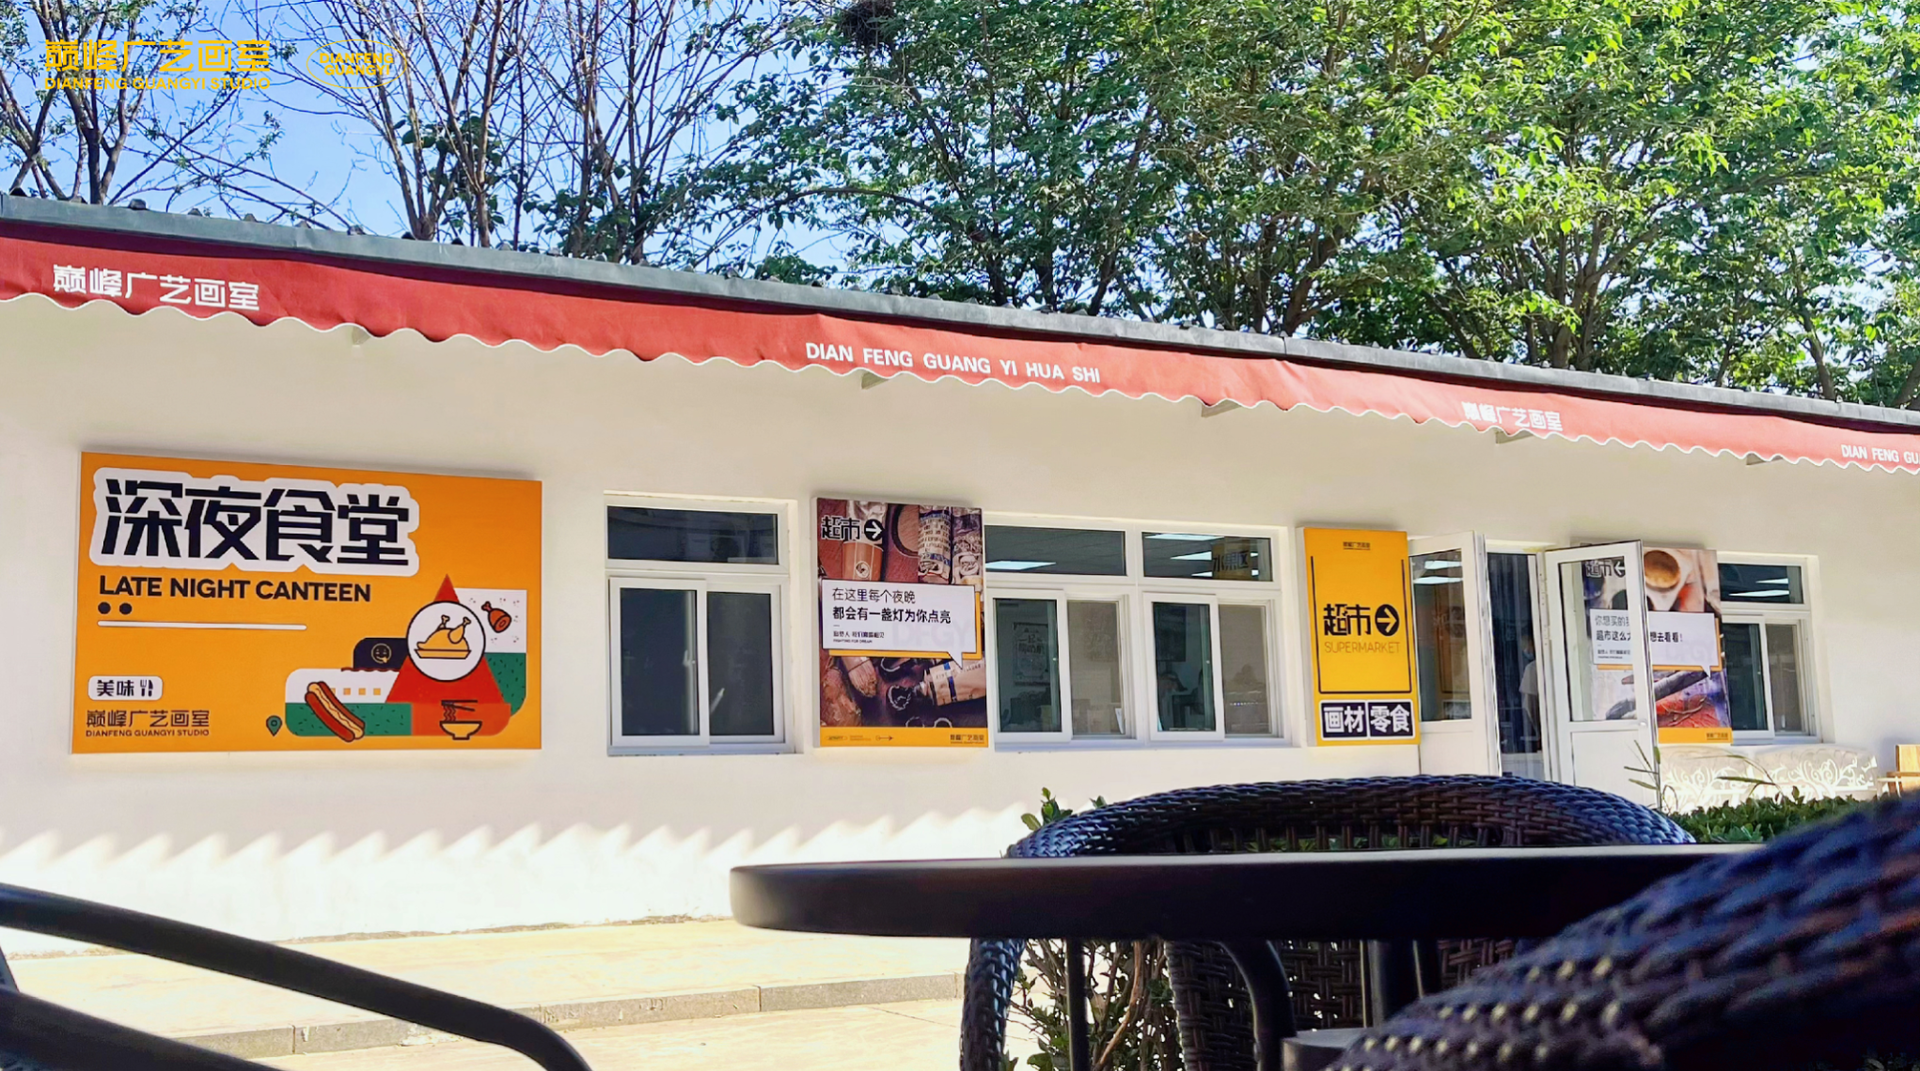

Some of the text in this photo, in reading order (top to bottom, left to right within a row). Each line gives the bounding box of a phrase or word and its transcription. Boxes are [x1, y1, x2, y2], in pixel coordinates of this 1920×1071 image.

[53, 264, 260, 311] 巅峰广艺画室
[806, 342, 1100, 383] DIAN FENG GUANG YI HUA SHI
[1841, 444, 1920, 465] DIAN FENG GU
[100, 478, 409, 566] 深夜食堂
[821, 515, 860, 541] 超市
[99, 575, 371, 602] LATE NIGHT CANTEEN
[832, 587, 916, 604] 在这里每个夜晚
[832, 606, 952, 624] 都会有一盏灯为你点亮
[1323, 604, 1372, 636] 超市
[1324, 641, 1400, 654] SUPERMARKET
[96, 679, 135, 697] 美味
[86, 709, 210, 728] 巅峰广艺画室
[1323, 706, 1366, 733] 画材
[1370, 704, 1411, 733] 零食
[85, 729, 210, 737] DIANFENG GUANGYI STUDIO
